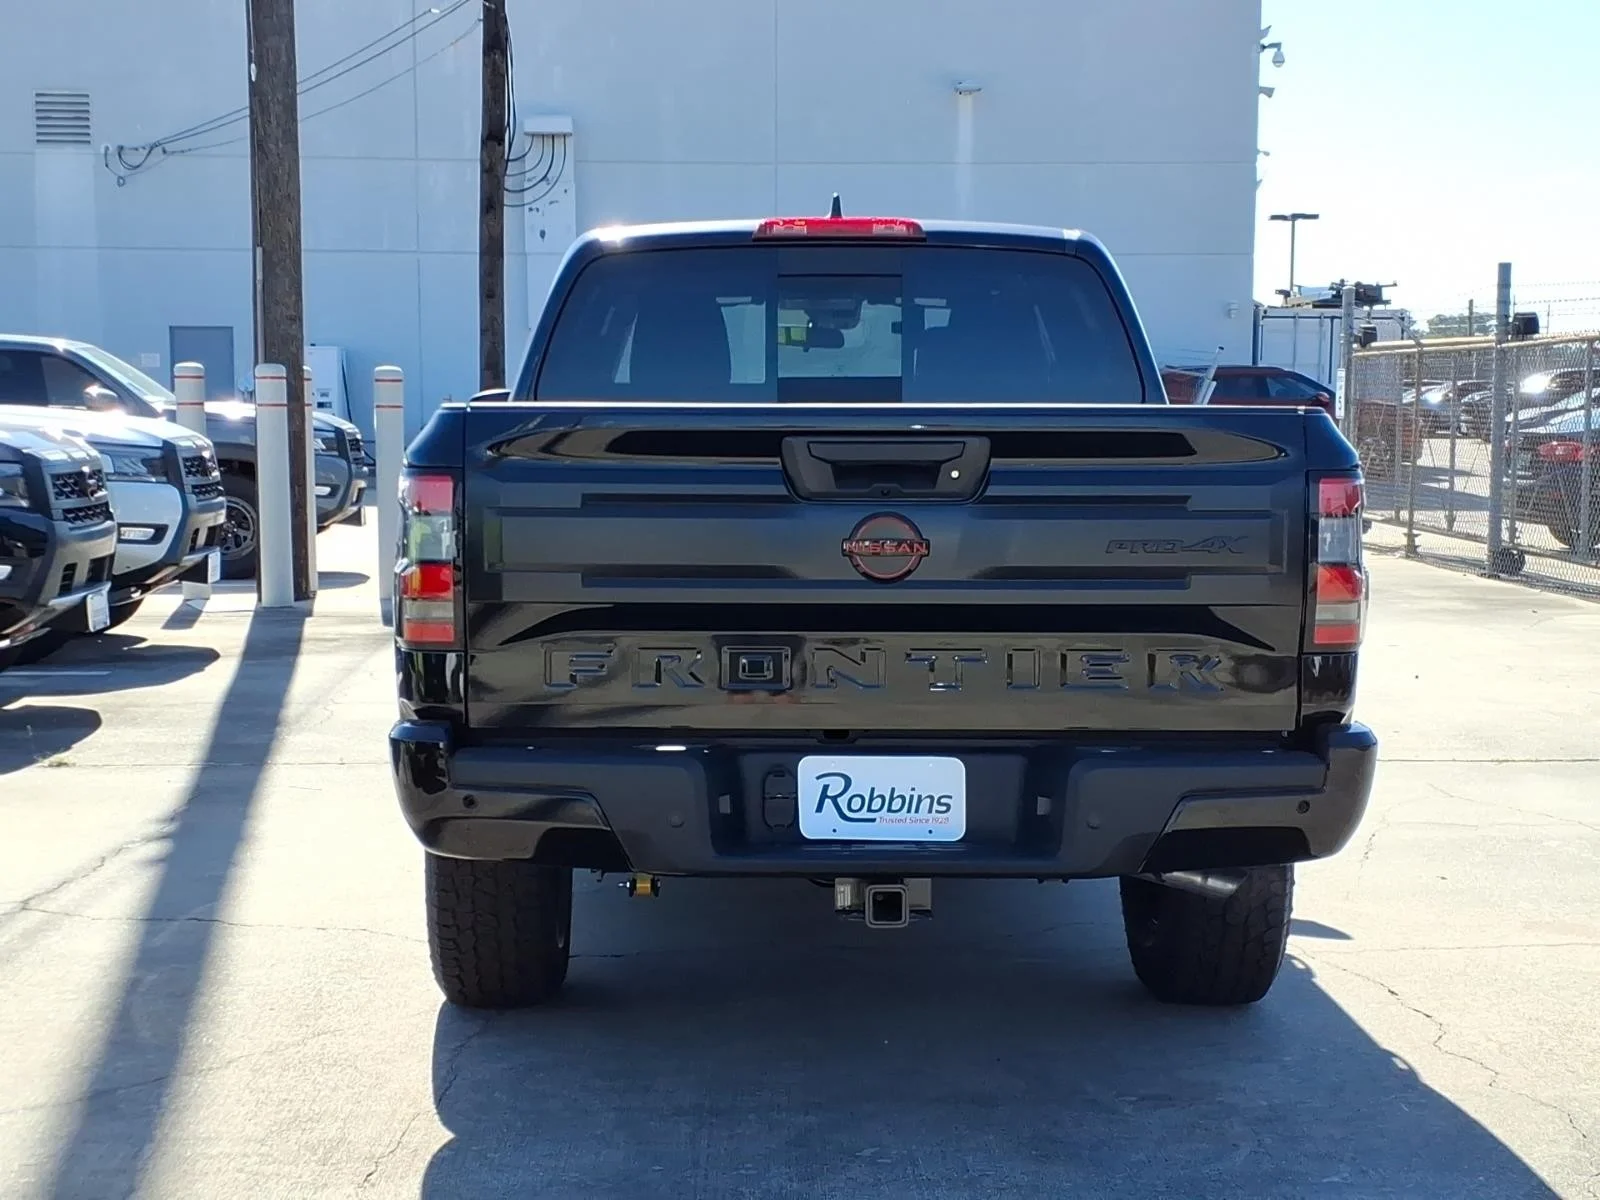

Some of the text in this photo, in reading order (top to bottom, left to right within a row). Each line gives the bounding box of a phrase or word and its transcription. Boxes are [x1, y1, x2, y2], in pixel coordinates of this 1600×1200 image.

[843, 541, 928, 554] NISSAN
[1105, 536, 1249, 554] PRO-4X
[543, 645, 1225, 691] FRONTIER
[815, 772, 953, 823] Robbins
[879, 816, 907, 824] Trusted
[908, 816, 930, 824] Since
